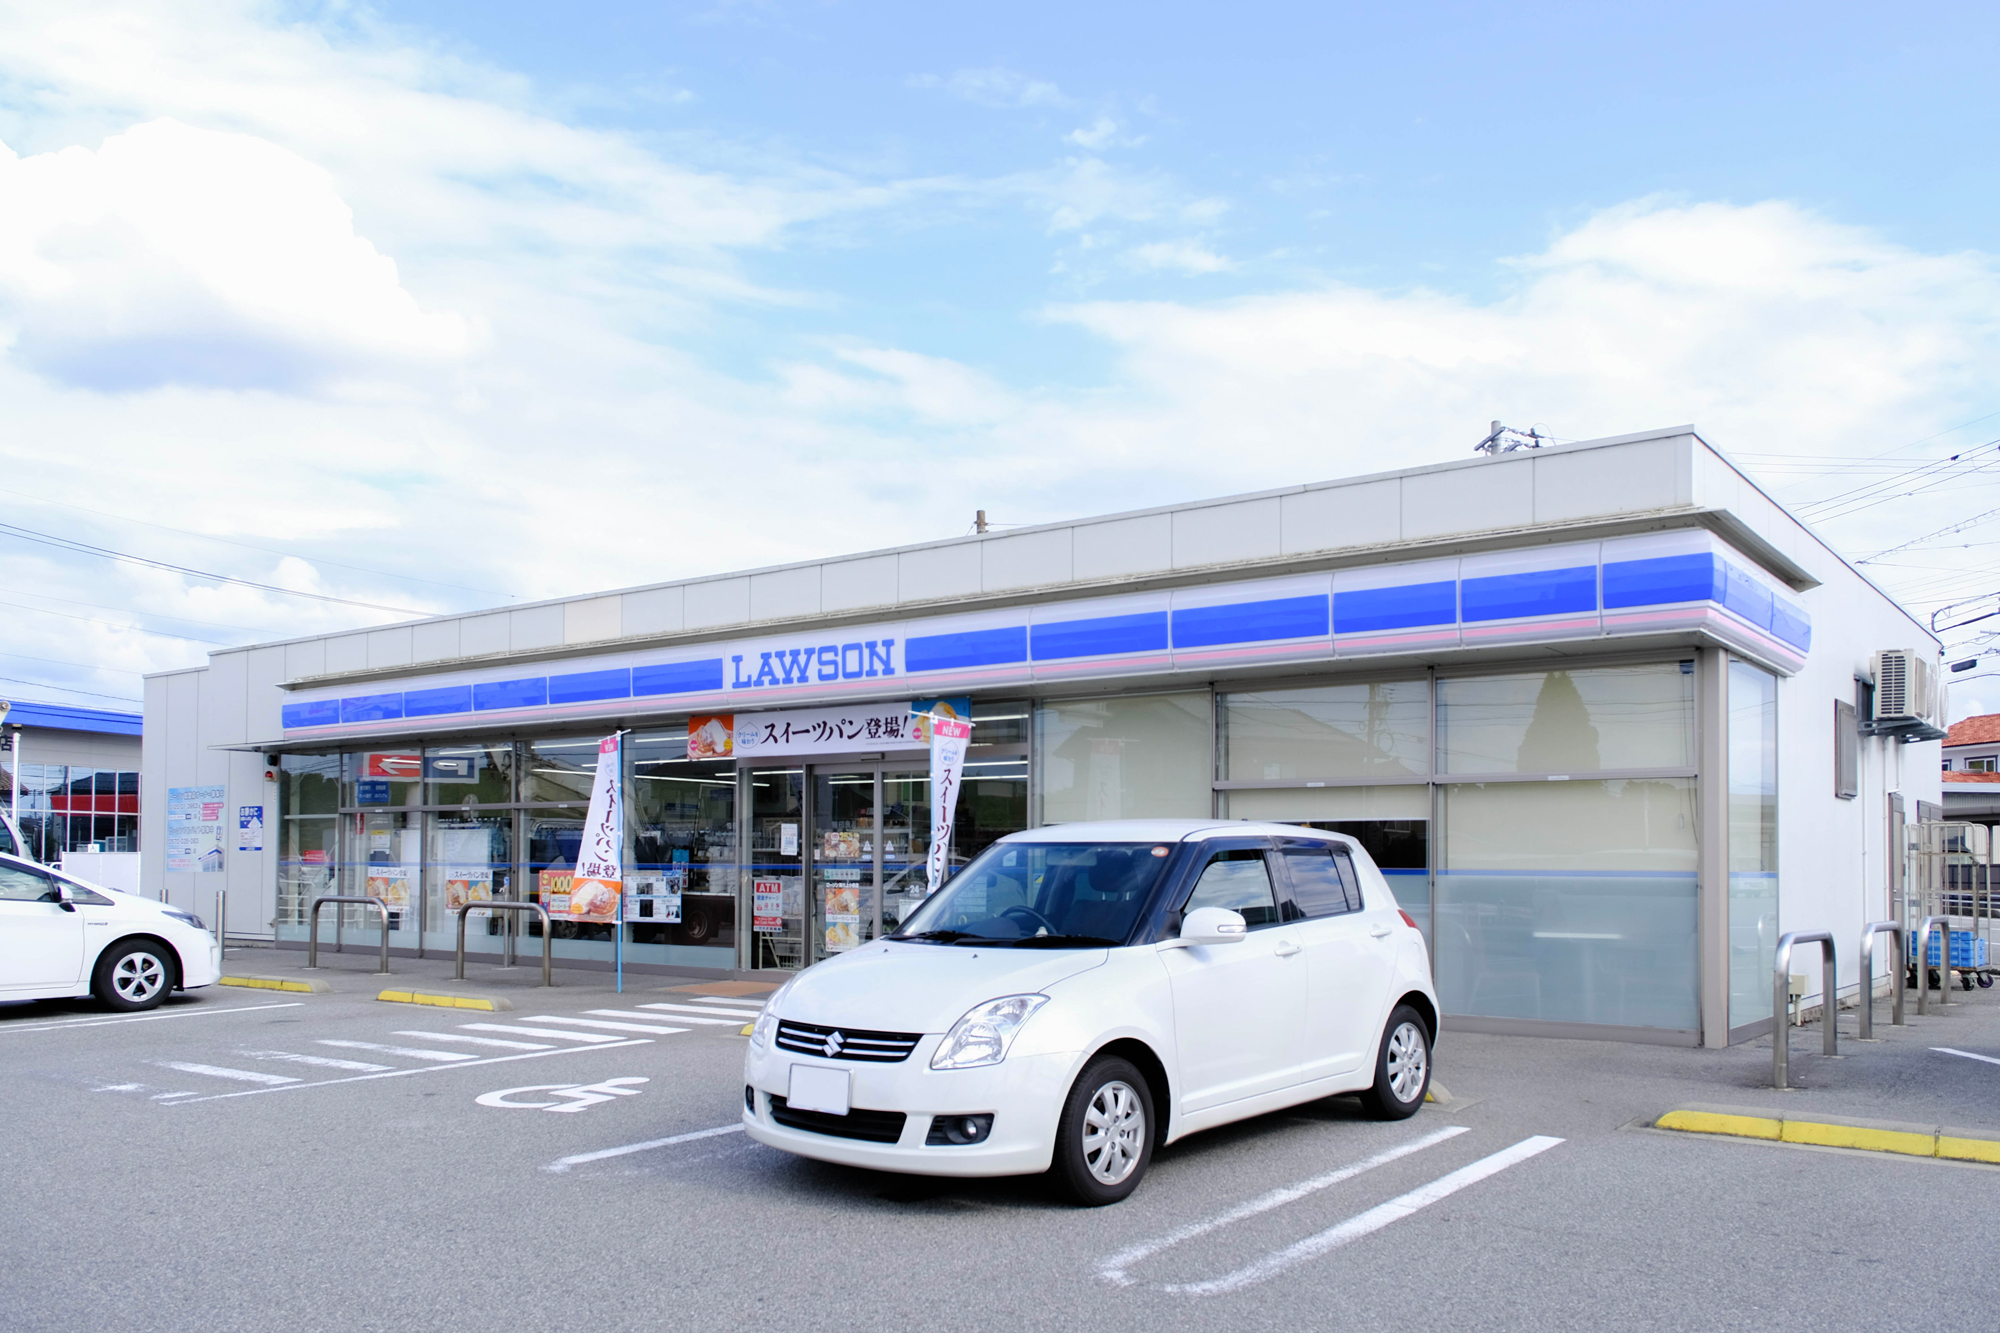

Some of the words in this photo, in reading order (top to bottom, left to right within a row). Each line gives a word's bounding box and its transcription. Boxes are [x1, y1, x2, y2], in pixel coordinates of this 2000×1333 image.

[732, 639, 895, 689] LAWSON
[761, 715, 908, 744] スイーツパン登場!
[942, 725, 961, 737] NEW
[758, 883, 779, 893] ATM
[910, 884, 920, 894] 24
